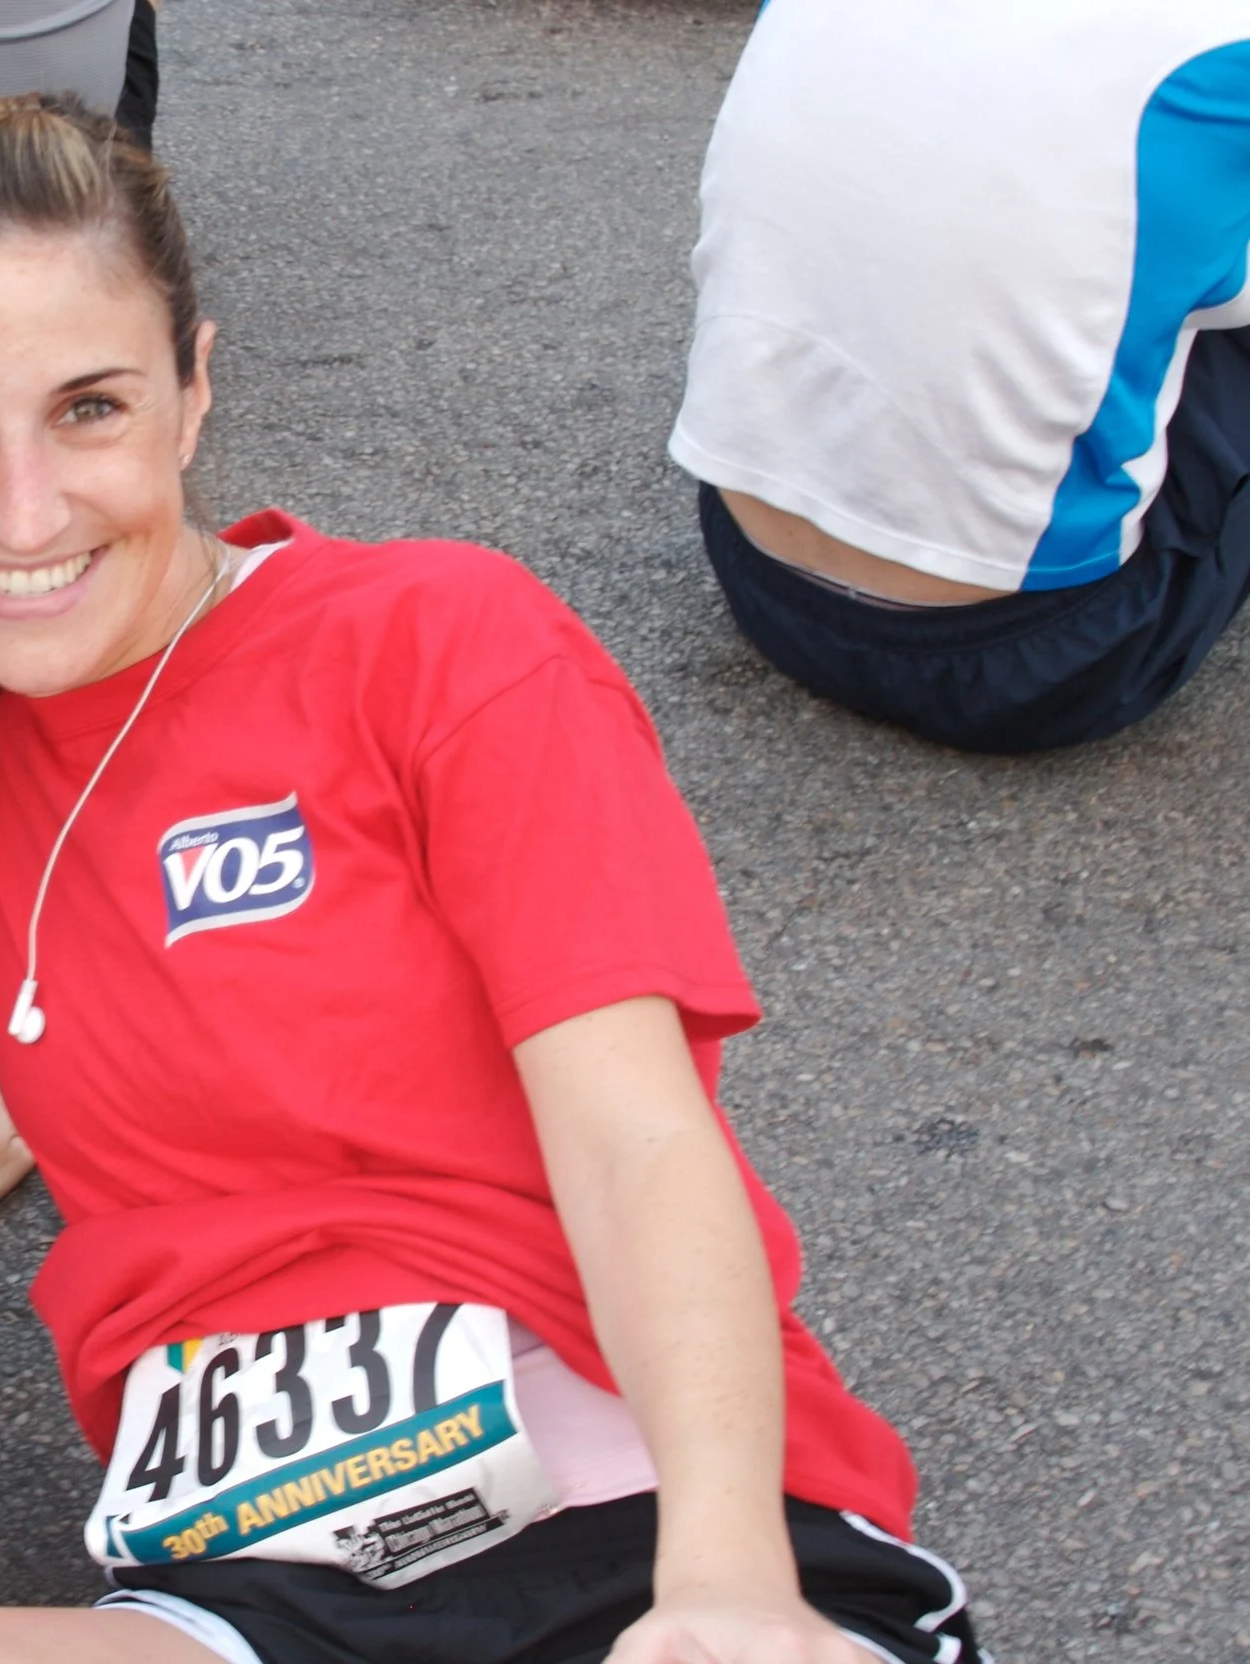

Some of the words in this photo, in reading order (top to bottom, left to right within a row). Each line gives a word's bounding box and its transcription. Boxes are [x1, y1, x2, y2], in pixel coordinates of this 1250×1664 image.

[168, 832, 219, 851] Alberto
[125, 1302, 461, 1504] 46337
[162, 1510, 227, 1561] 30th
[236, 1404, 486, 1537] ANNIVERSARY
